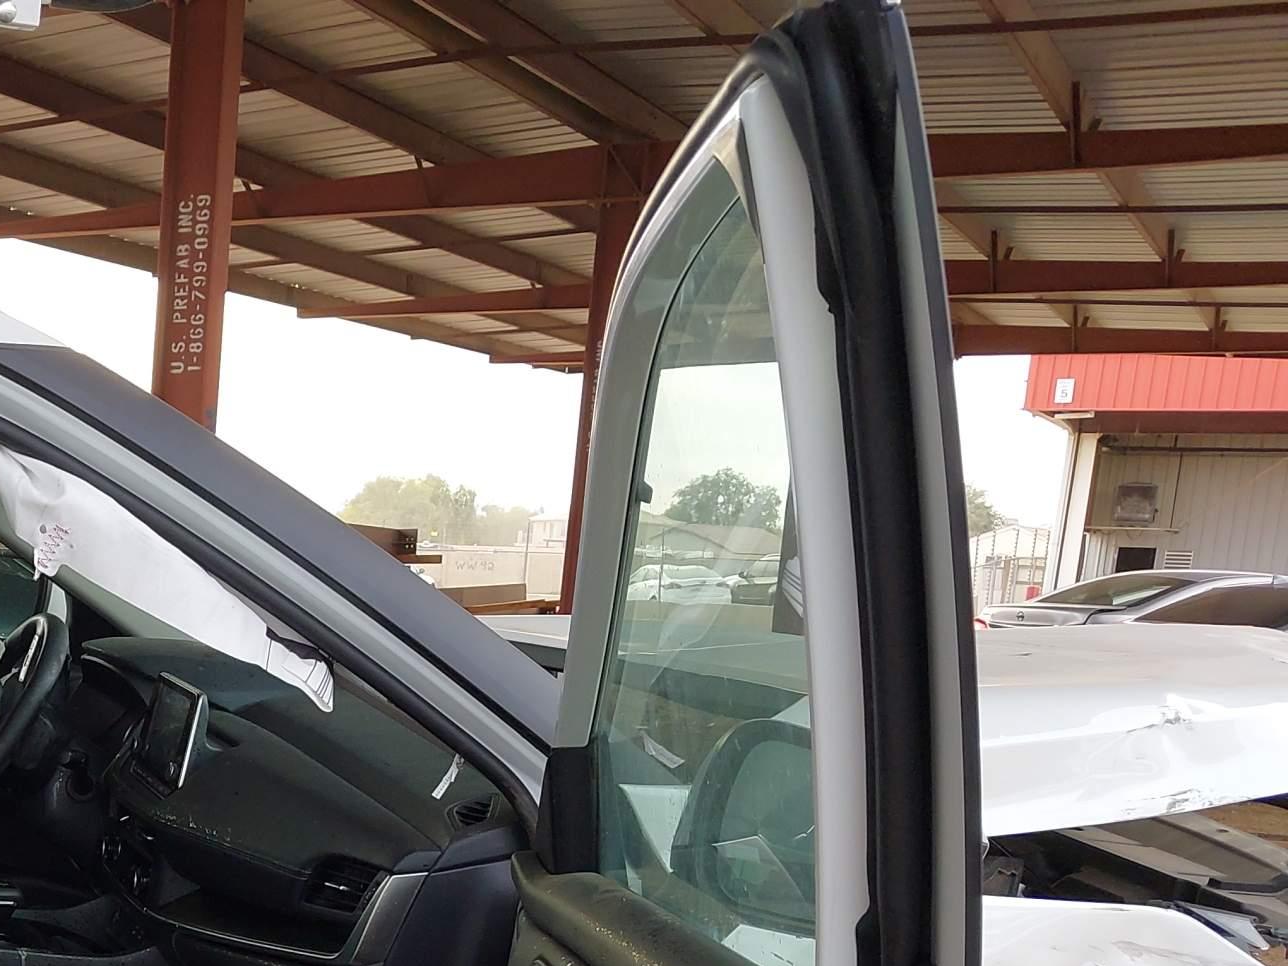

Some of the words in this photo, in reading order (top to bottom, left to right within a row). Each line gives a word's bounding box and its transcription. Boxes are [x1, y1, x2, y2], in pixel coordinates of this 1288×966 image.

[177, 193, 194, 233] INC.
[172, 243, 191, 323] PREFAB
[187, 193, 211, 373] 1-866-799-0969
[170, 335, 186, 374] U.S.
